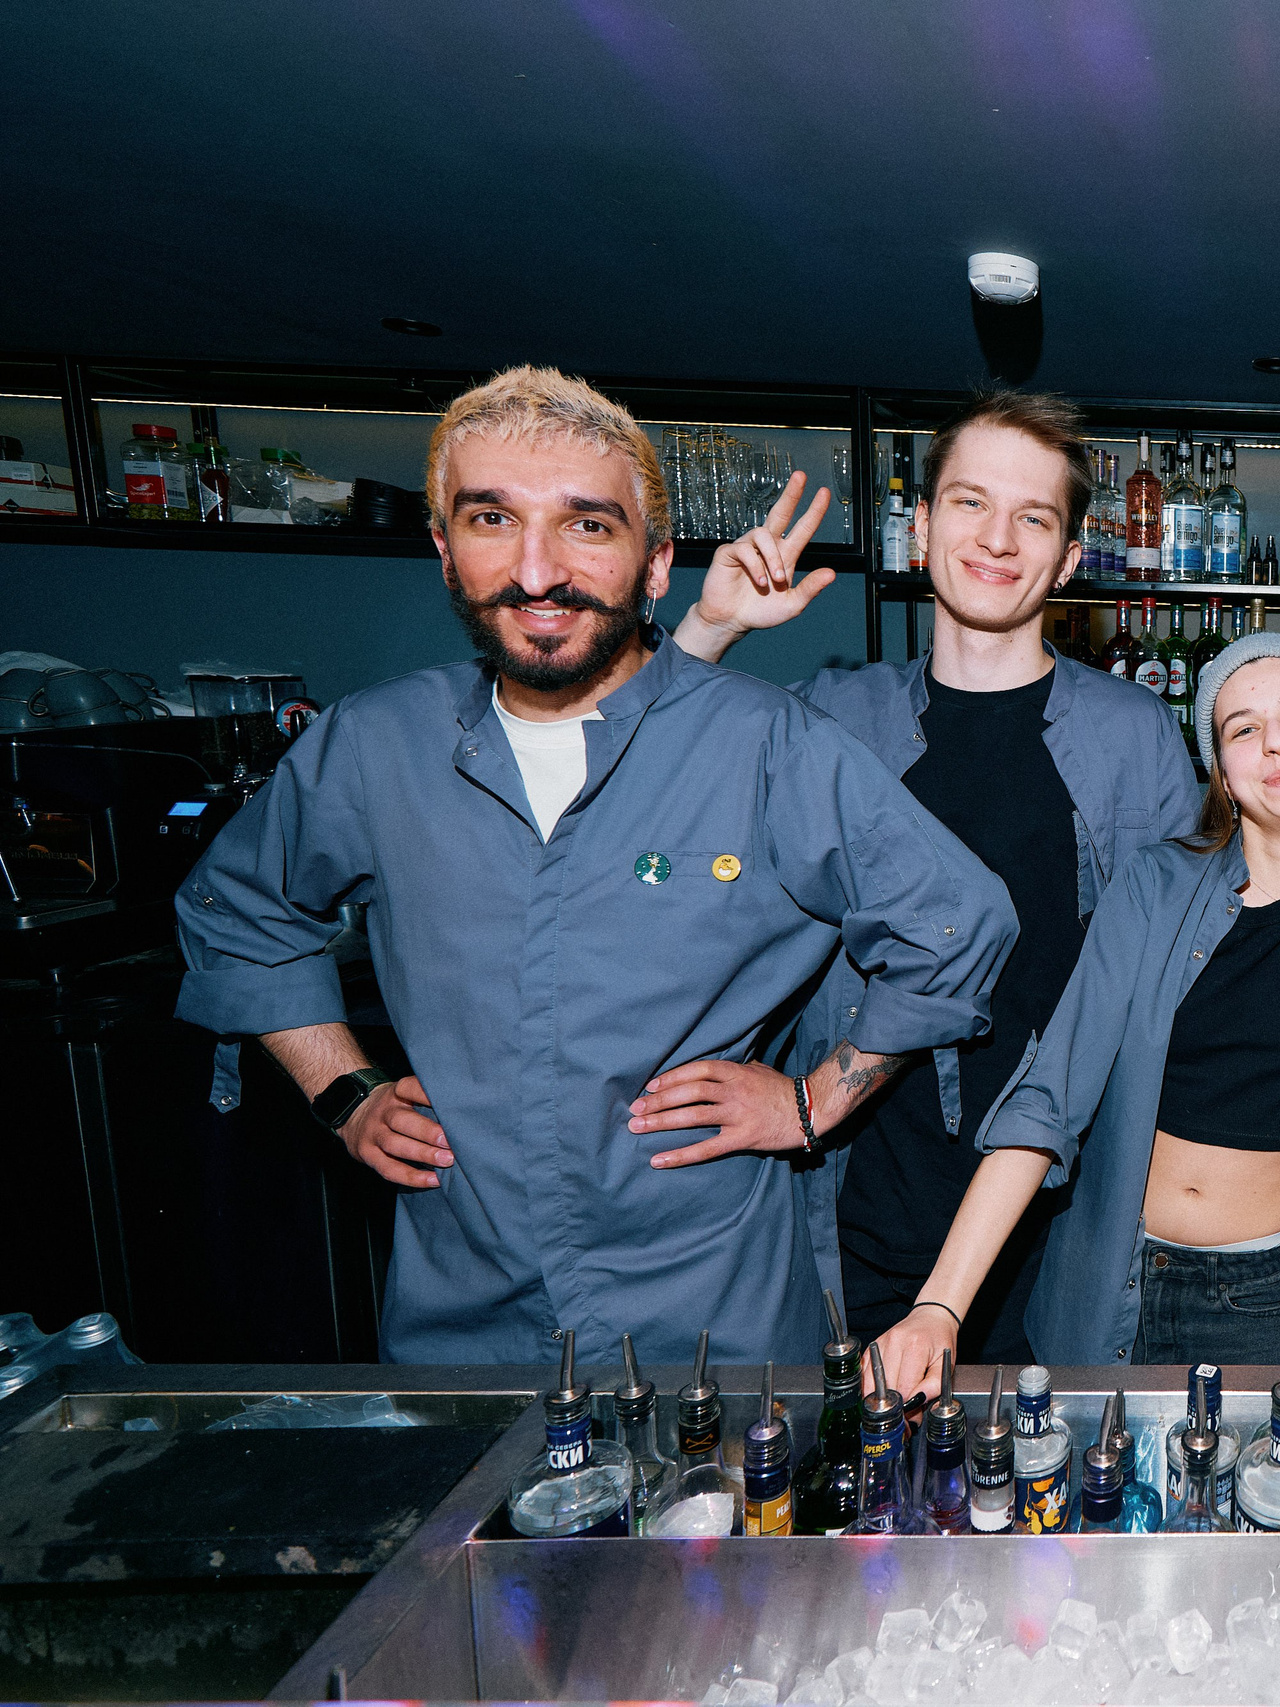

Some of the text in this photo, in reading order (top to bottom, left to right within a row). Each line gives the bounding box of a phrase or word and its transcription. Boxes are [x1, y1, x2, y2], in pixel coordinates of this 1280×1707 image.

[1131, 513, 1158, 521] WHTLEY
[1177, 520, 1192, 531] Ben
[1213, 535, 1234, 547] amgo
[863, 1441, 891, 1454] APEROL
[549, 1444, 584, 1469] СКИ
[1044, 1481, 1067, 1514] ХА
